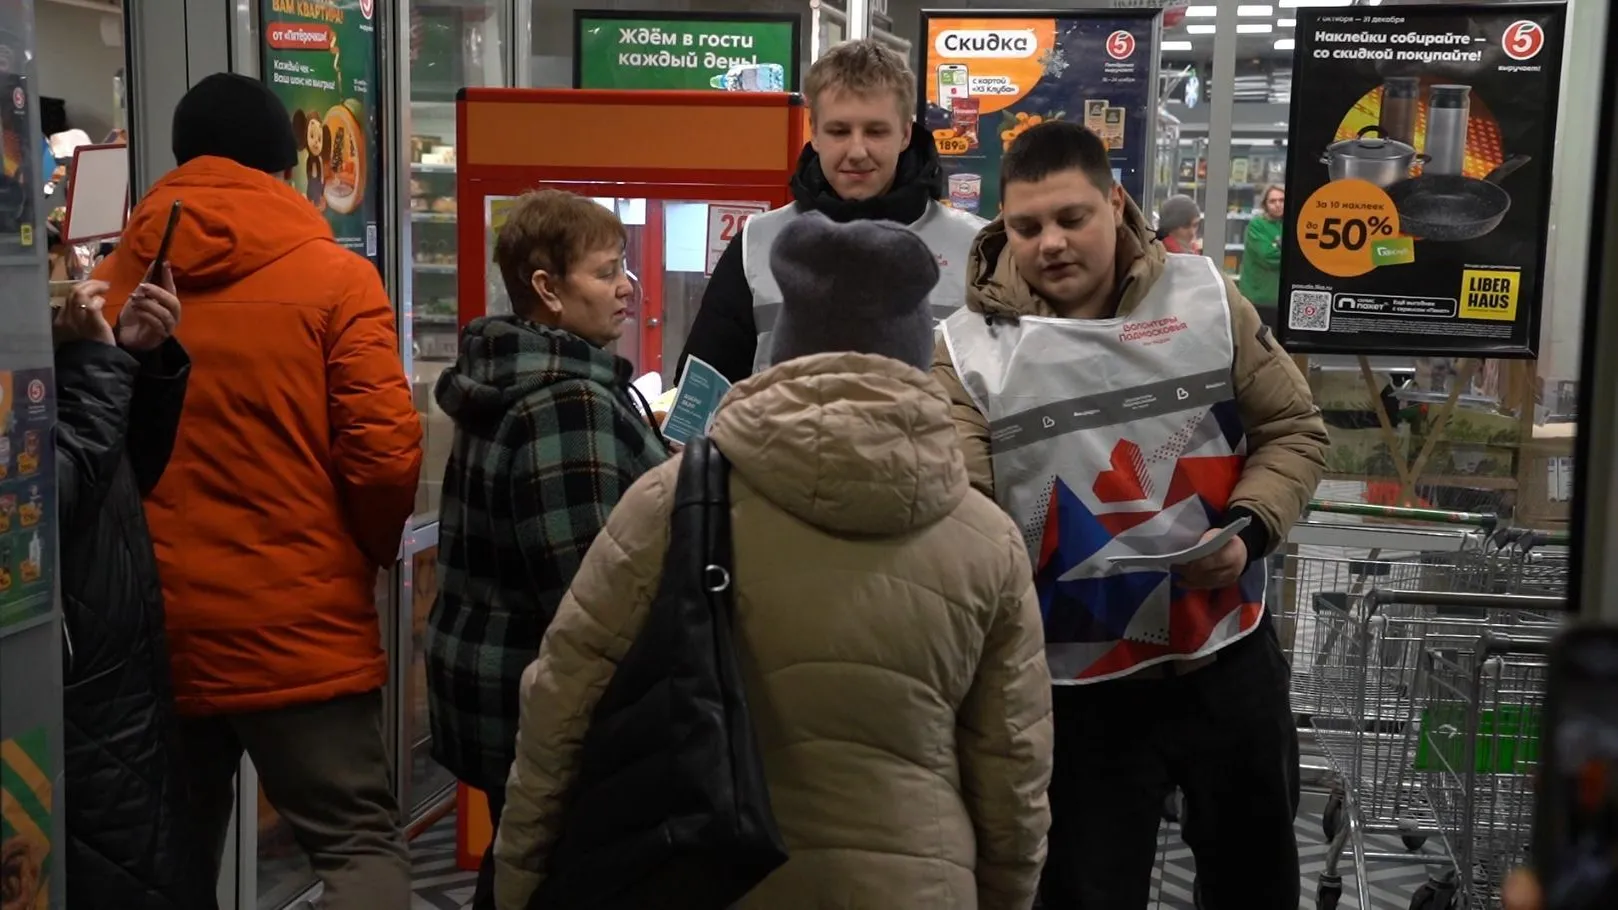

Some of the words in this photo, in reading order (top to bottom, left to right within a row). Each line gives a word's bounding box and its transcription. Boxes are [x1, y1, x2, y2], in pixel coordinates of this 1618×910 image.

[1371, 16, 1405, 24] декабря
[618, 28, 677, 45] Ждём
[683, 34, 693, 46] в
[699, 34, 753, 48] гости
[944, 33, 1028, 51] Скидка
[1314, 31, 1387, 44] Наклейки
[1390, 32, 1471, 46] собирайте
[618, 51, 698, 67] каждый
[1313, 49, 1330, 58] со
[1333, 48, 1393, 60] скидкой
[1396, 49, 1482, 62] покупайте!
[979, 77, 1007, 87] картой
[986, 85, 1015, 94] Клуба»
[1306, 221, 1318, 229] до
[1305, 216, 1393, 251] -50%
[1469, 277, 1511, 293] LIBER
[1468, 293, 1510, 309] HAUS
